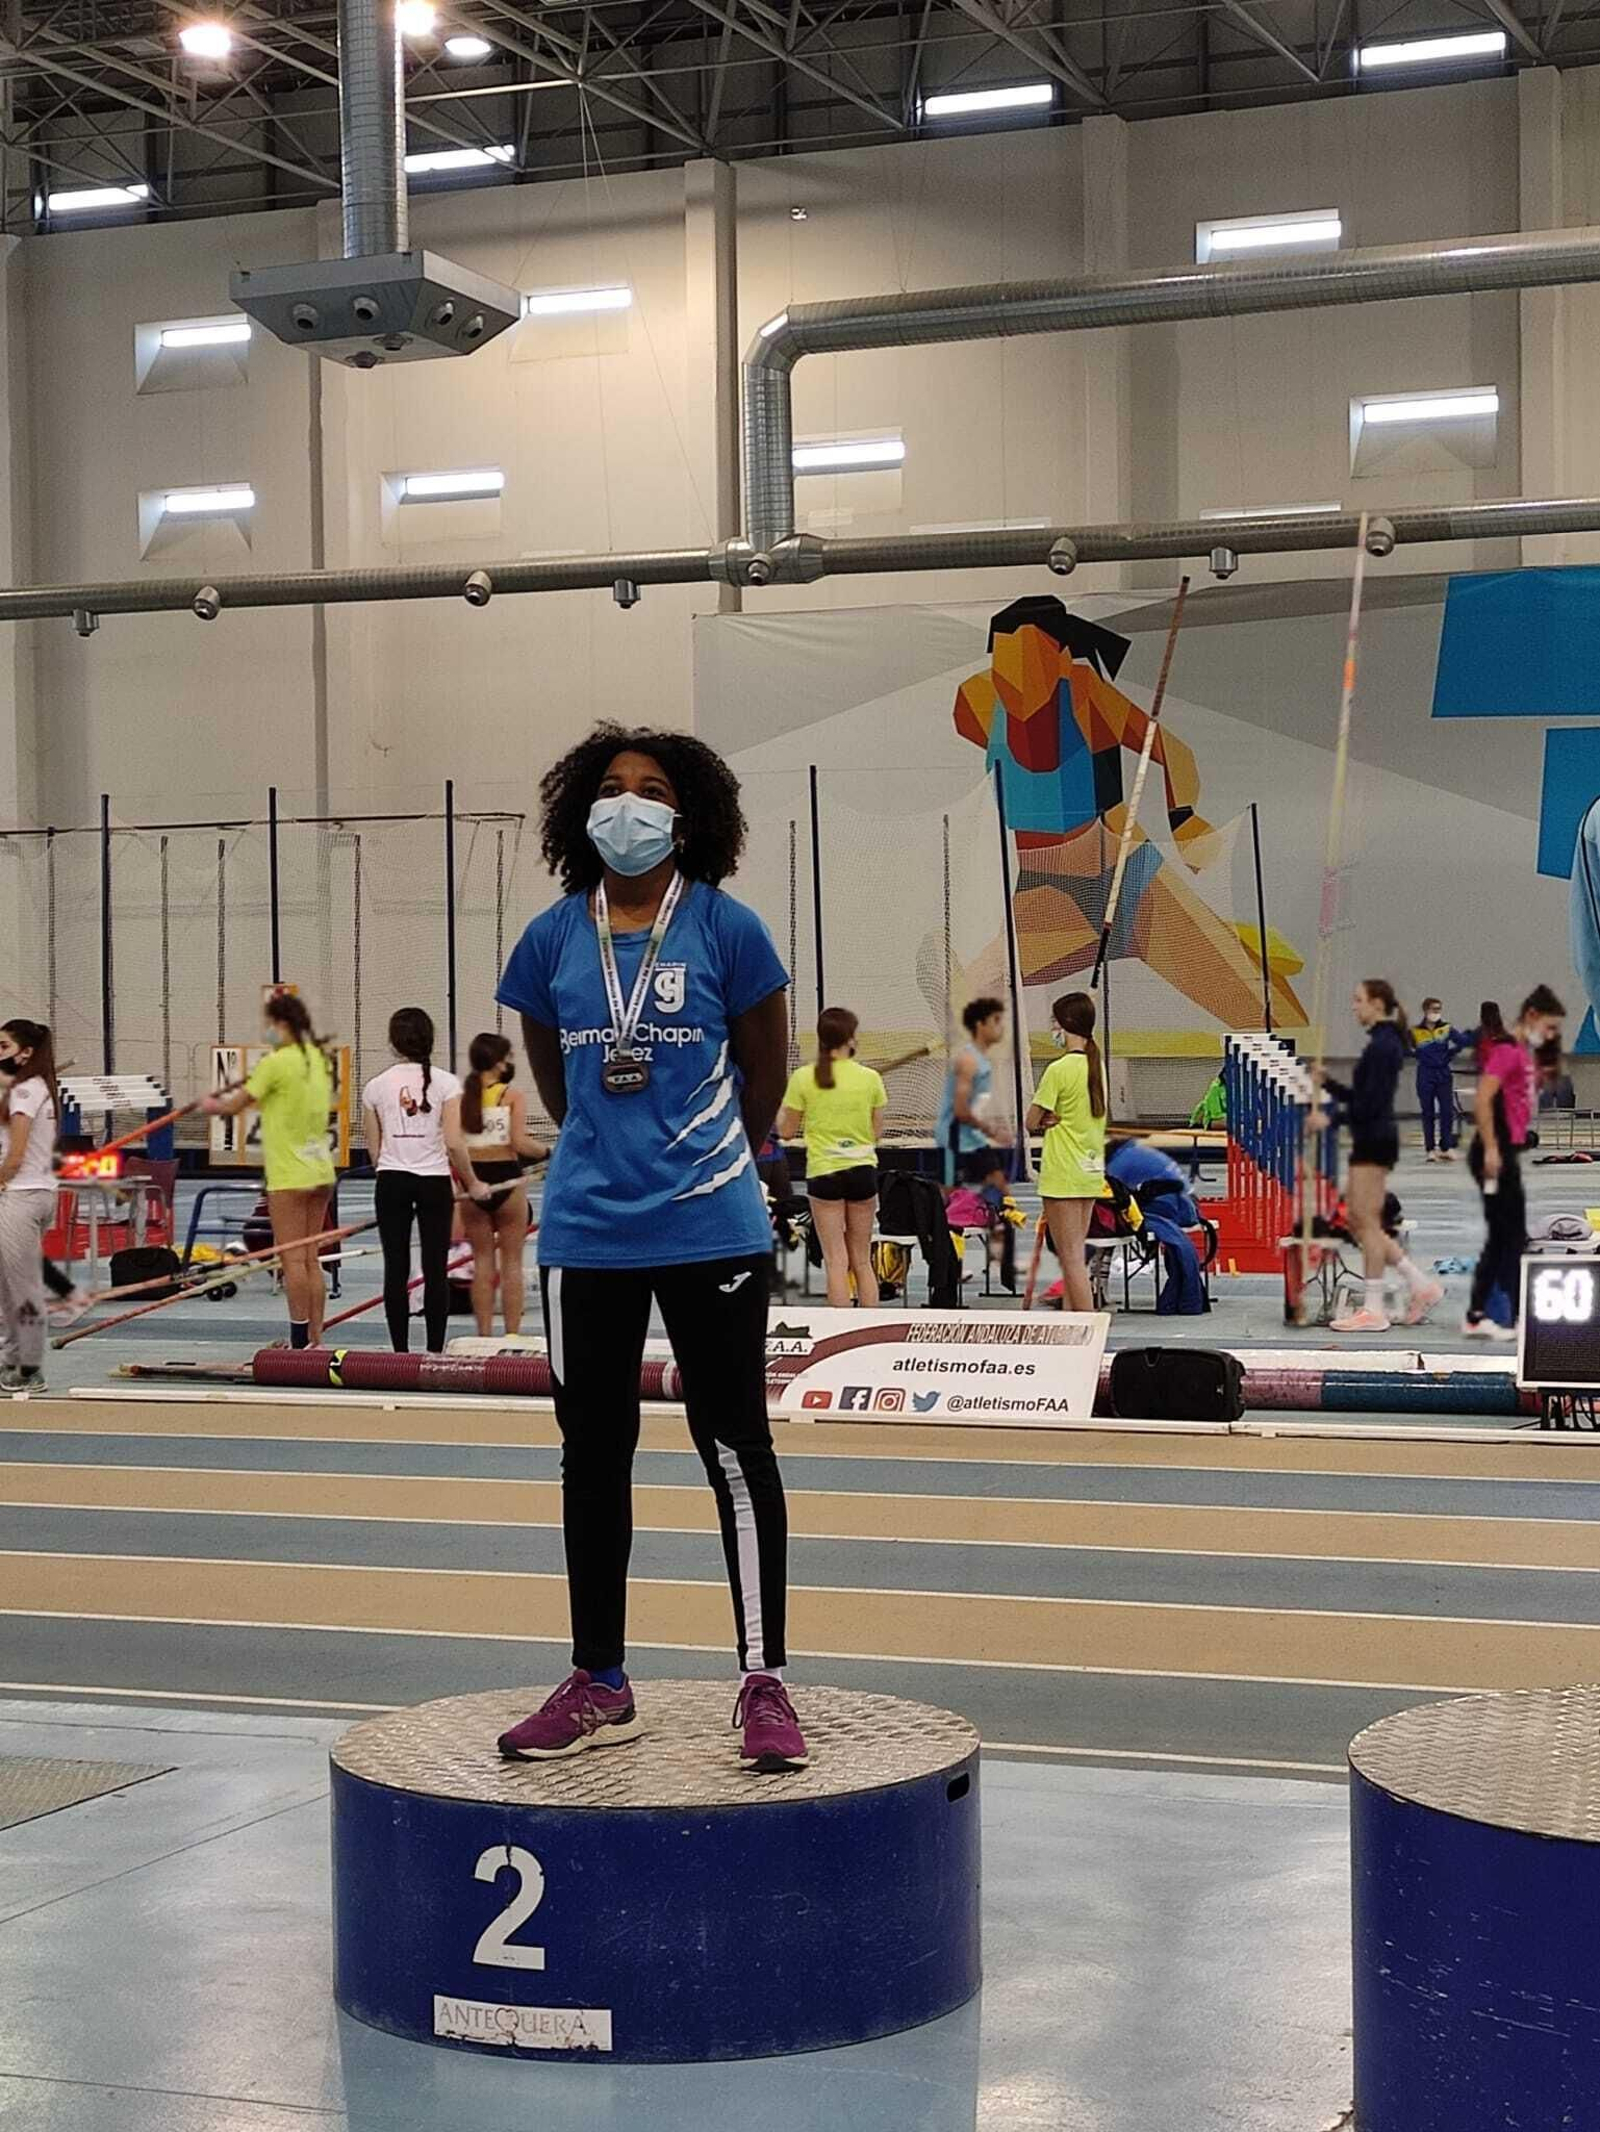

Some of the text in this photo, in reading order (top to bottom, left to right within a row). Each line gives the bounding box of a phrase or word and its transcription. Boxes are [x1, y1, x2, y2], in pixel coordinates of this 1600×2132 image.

[602, 1045, 654, 1063] Jeez
[1533, 1268, 1594, 1321] 60
[893, 1357, 1036, 1376] atletismofaa.es
[947, 1394, 1069, 1413] @atletismoFAA
[473, 1845, 545, 1970] 2
[439, 2002, 588, 2035] ANTEQUERA
